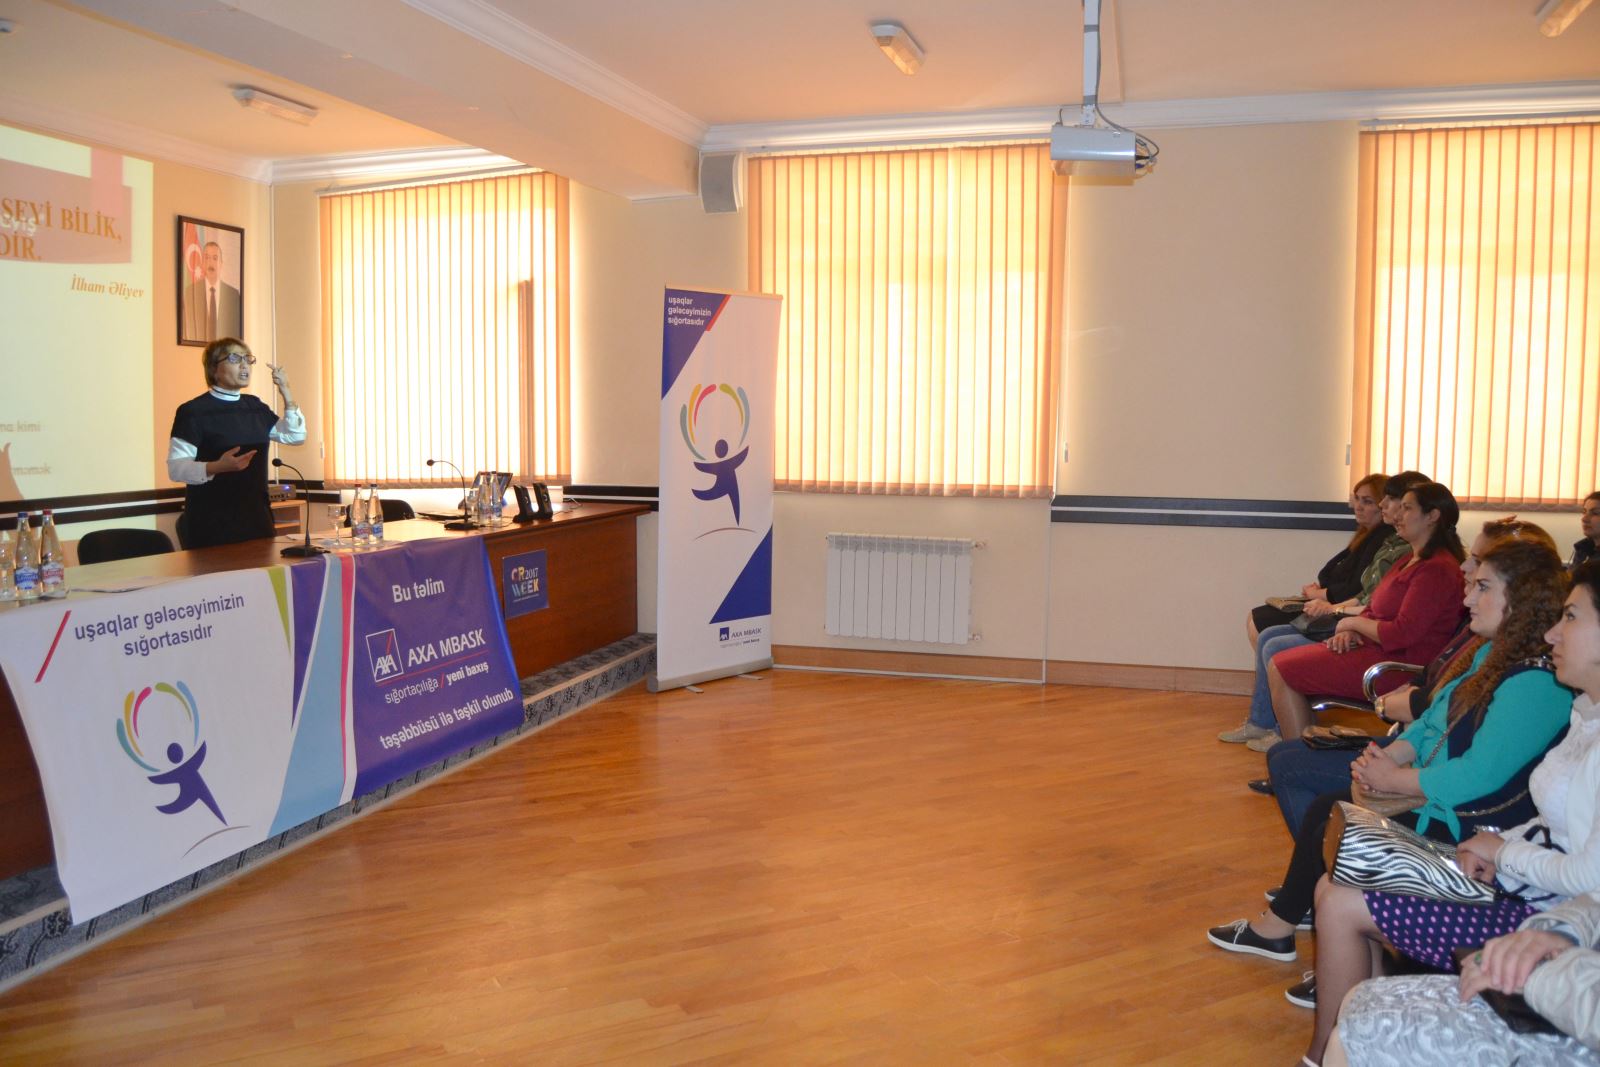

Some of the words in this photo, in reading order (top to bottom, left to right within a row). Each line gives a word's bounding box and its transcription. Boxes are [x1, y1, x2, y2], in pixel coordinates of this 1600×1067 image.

[71, 273, 105, 293] İlham
[392, 584, 412, 603] Bu
[413, 577, 445, 598] təlim
[511, 578, 539, 598] WEEK
[74, 614, 139, 642] uşaqlar
[144, 593, 245, 631] gələcəyimizin
[123, 623, 213, 657] sığortasıdır
[407, 643, 438, 667] AXA
[439, 628, 486, 658] MBASK
[374, 654, 398, 676] AXA
[384, 677, 439, 704] sığortaçılığa
[446, 667, 465, 686] yeni
[465, 661, 489, 676] baxış
[380, 714, 440, 749] təşəbbüsü
[440, 710, 454, 727] ilə
[453, 700, 482, 721] təşkil
[481, 687, 514, 710] olunub
